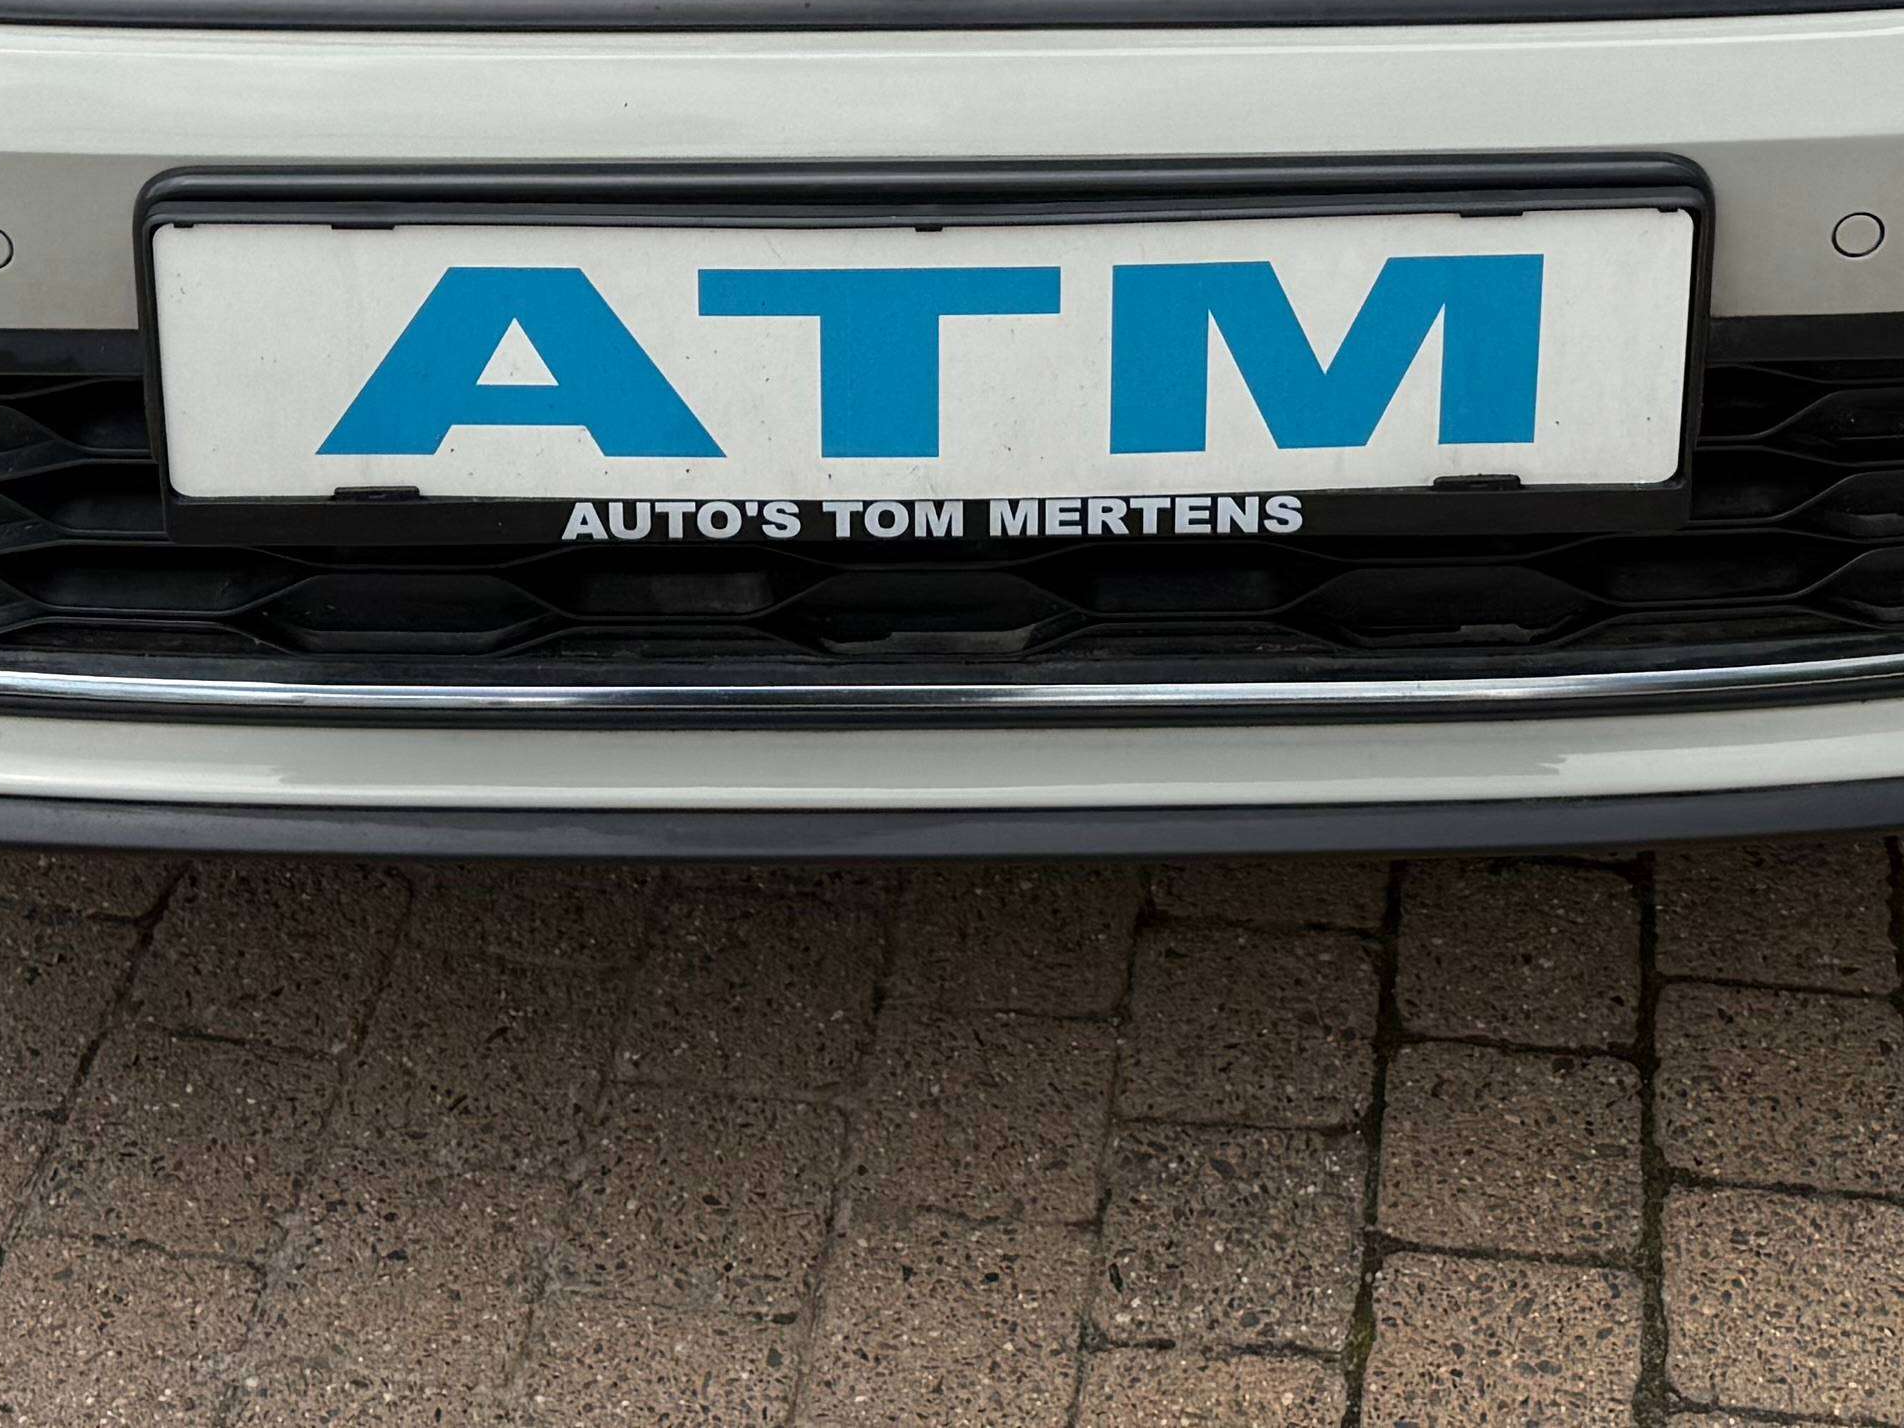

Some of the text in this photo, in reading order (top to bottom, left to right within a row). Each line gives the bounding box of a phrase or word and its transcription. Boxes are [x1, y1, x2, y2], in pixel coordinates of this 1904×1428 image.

[315, 253, 1545, 459] ATM
[561, 494, 1305, 540] AUTO'S TOM MERTENS
